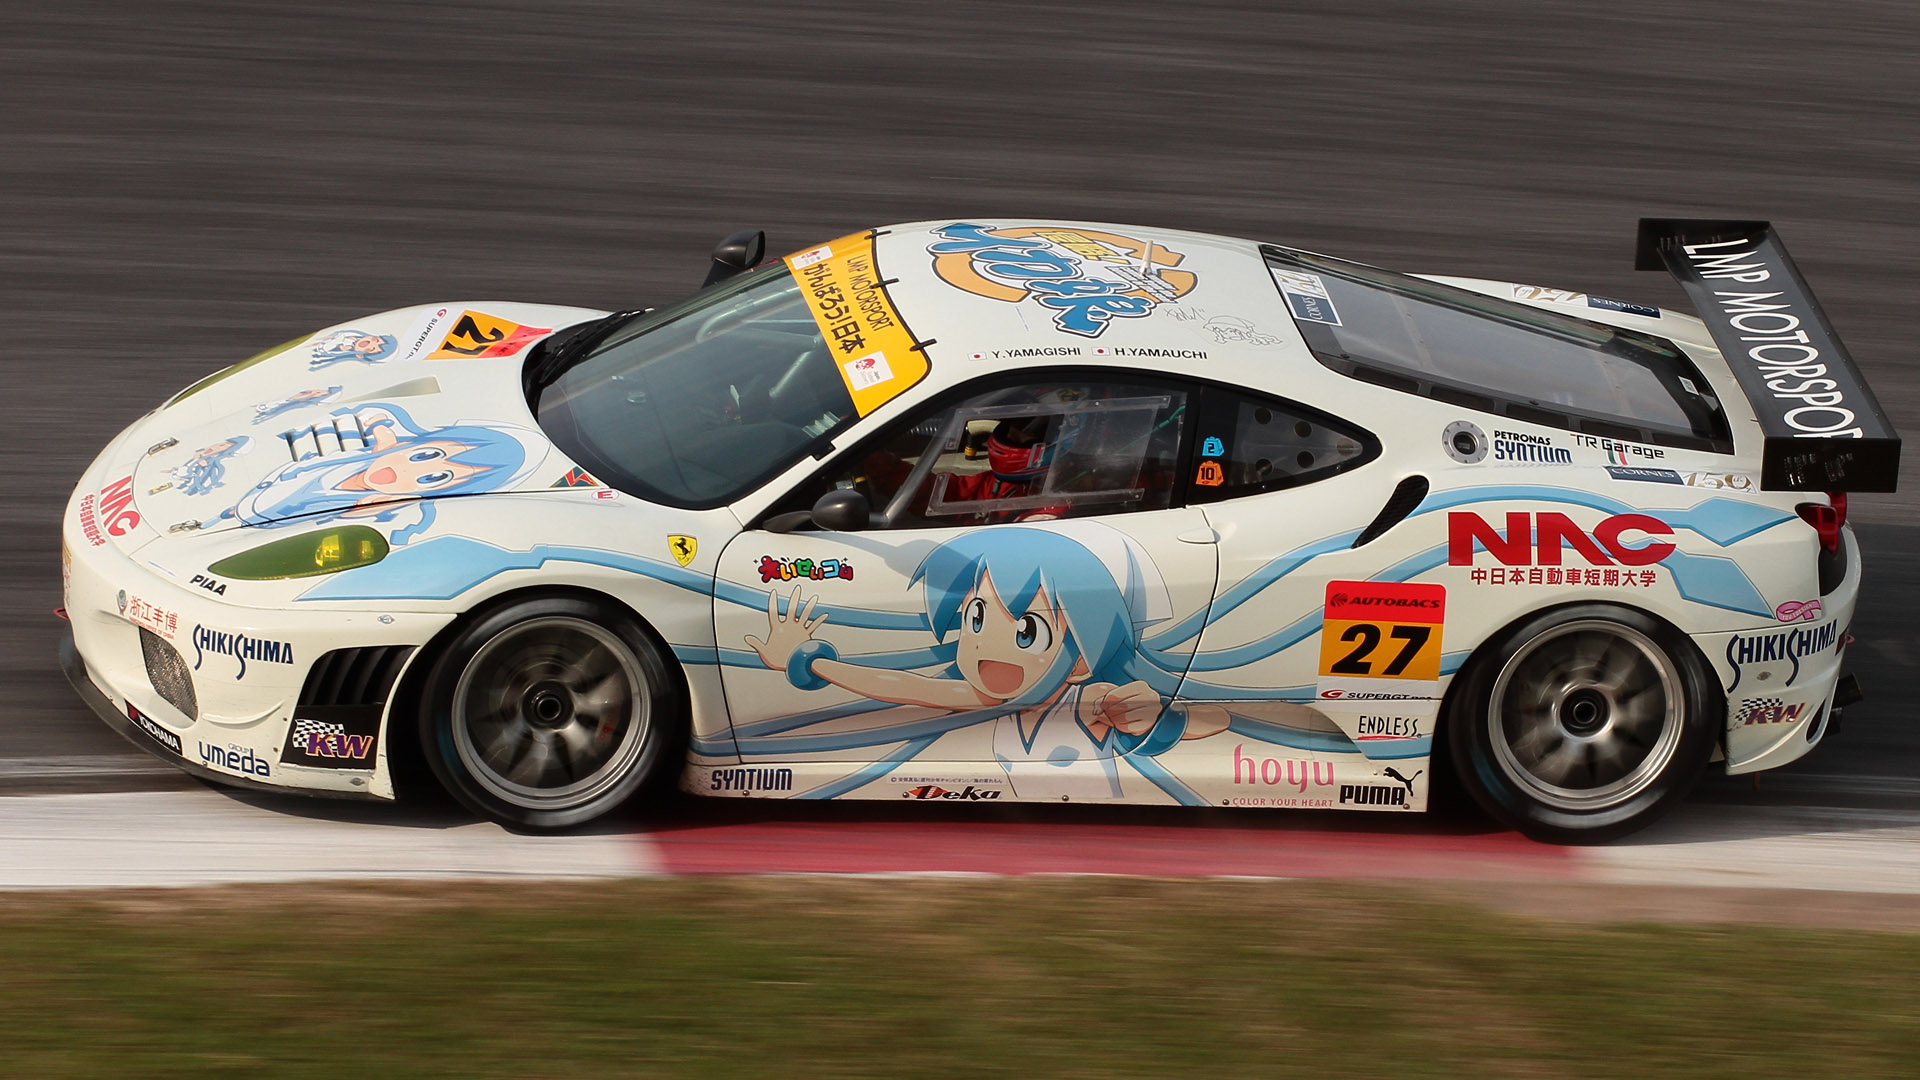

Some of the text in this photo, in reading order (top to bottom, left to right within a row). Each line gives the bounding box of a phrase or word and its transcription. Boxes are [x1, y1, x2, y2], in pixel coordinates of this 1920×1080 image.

[847, 253, 869, 273] LMP
[850, 273, 895, 332] MOTORSPORT
[442, 314, 505, 355] 27
[1682, 238, 1864, 438] LMP MOTORSPO
[991, 347, 1081, 359] Y.YAMAGISHI
[1115, 347, 1208, 360] H.YAMAUCHI
[1207, 442, 1215, 453] 2
[1494, 430, 1551, 446] PETRONAS
[1570, 433, 1665, 459] TR Garage
[1495, 440, 1573, 463] SYNTIUM
[1200, 467, 1215, 480] 10
[1612, 468, 1675, 478] CORNES
[100, 475, 140, 537] NAC
[1448, 511, 1677, 566] NAC
[189, 574, 227, 596] PIAA
[1471, 567, 1656, 587] 中日本自動車短期大学
[130, 595, 177, 633] 浙江丰博
[1348, 596, 1440, 609] AUTOBACS
[192, 623, 294, 681] SHIKISHIMA
[1330, 623, 1432, 676] 27
[1726, 619, 1838, 694] SHIKISHIMA
[1744, 702, 1806, 726] KW
[137, 711, 180, 751] YOKOHAMA
[1358, 715, 1419, 737] ENDLESS
[228, 742, 250, 754] GROUP
[305, 732, 375, 760] KW
[199, 741, 271, 777] umeda
[1233, 743, 1335, 793] hoyu
[711, 768, 793, 791] SYNTIUM
[914, 784, 1002, 801] Deka
[1232, 797, 1334, 808] COLOR YOUR HEART
[1339, 784, 1406, 806] PUMA
